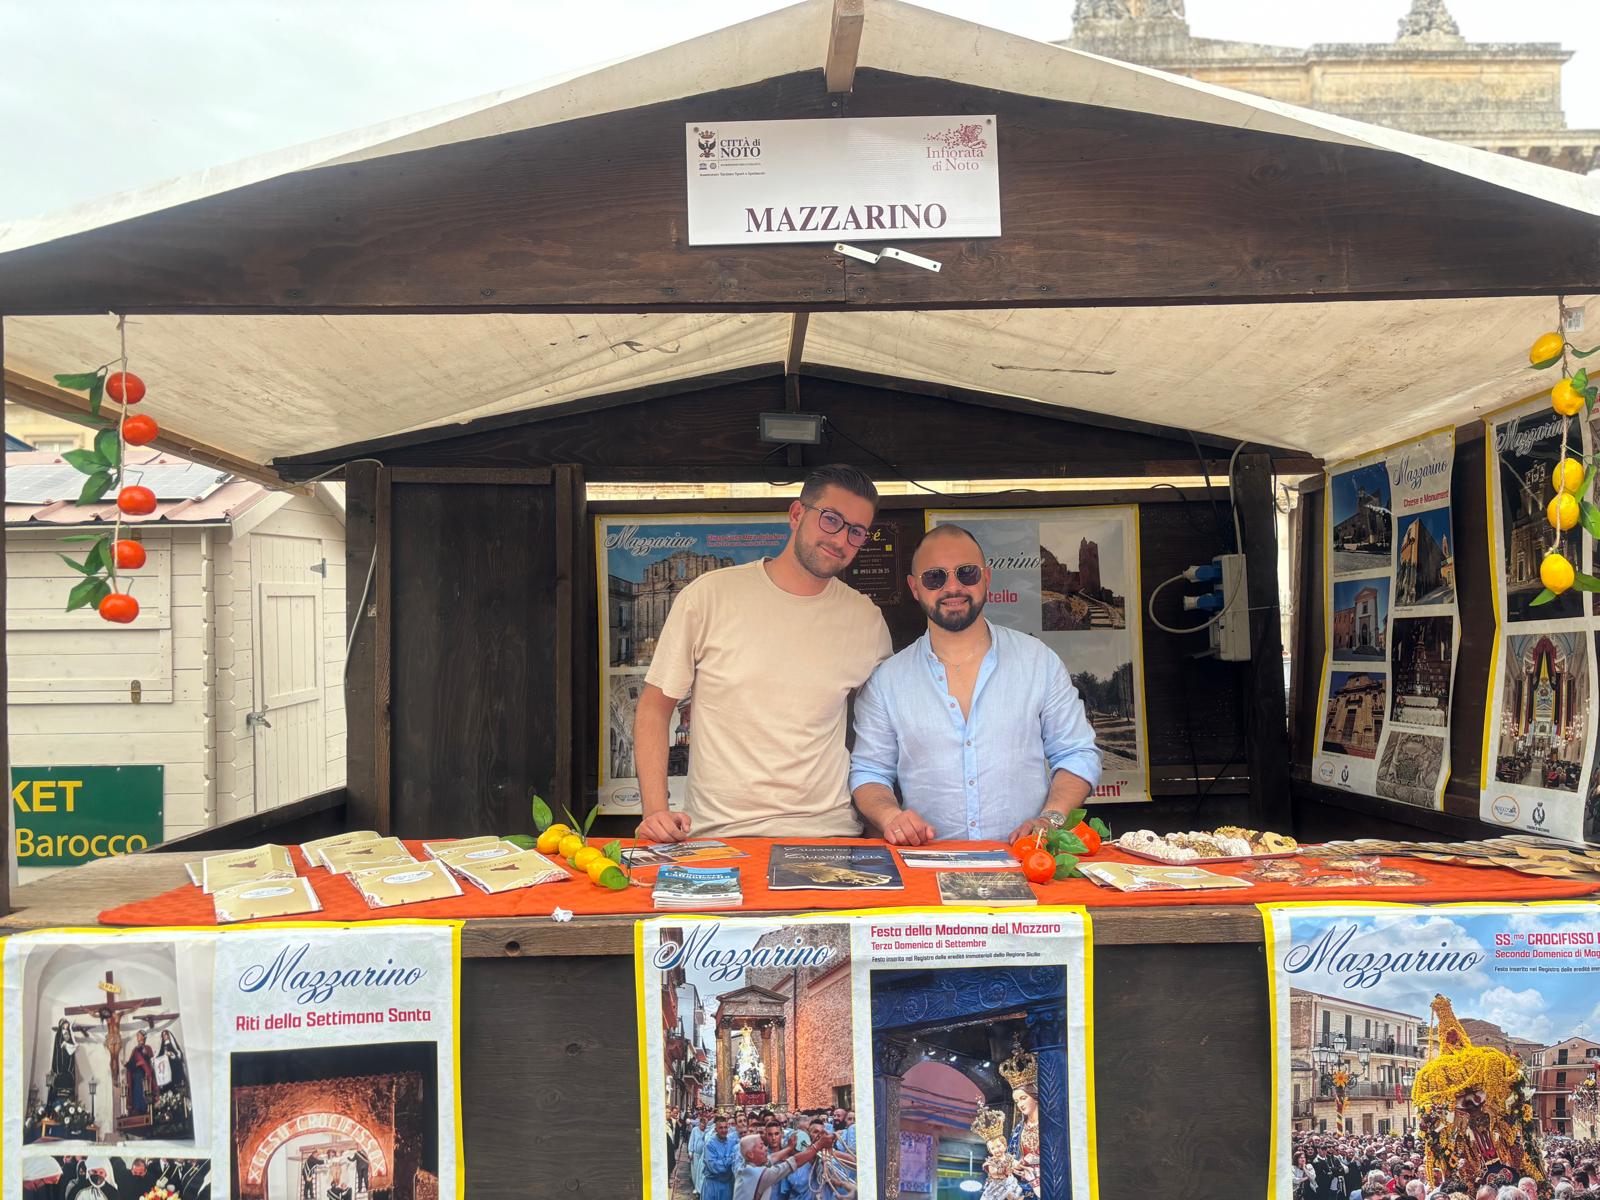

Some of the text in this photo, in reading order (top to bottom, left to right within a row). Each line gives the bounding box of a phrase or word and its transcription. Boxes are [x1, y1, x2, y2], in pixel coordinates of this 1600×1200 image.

[720, 137, 761, 147] CITTÀ di
[720, 146, 761, 158] NOTO
[927, 147, 984, 158] Infiorata
[932, 158, 979, 171] di Noto
[745, 203, 947, 233] MAZZARINO
[1393, 455, 1447, 489] Mazzarino
[604, 525, 697, 557] Mazzarino
[16, 828, 148, 857] Barocco
[871, 922, 1061, 937] Festa della Madonna del Mazzaro
[1528, 932, 1594, 945] CROCIFISSO
[653, 923, 834, 982] Mazzarino
[871, 939, 986, 951] Terza Domenica di Settembre
[1495, 949, 1530, 958] Seconda
[1533, 949, 1573, 958] Domenica
[1575, 949, 1582, 957] di
[1283, 924, 1485, 989] Mazzarino
[239, 943, 427, 1005] Mazzarino
[236, 1008, 431, 1031] Riti della Settimana Santa
